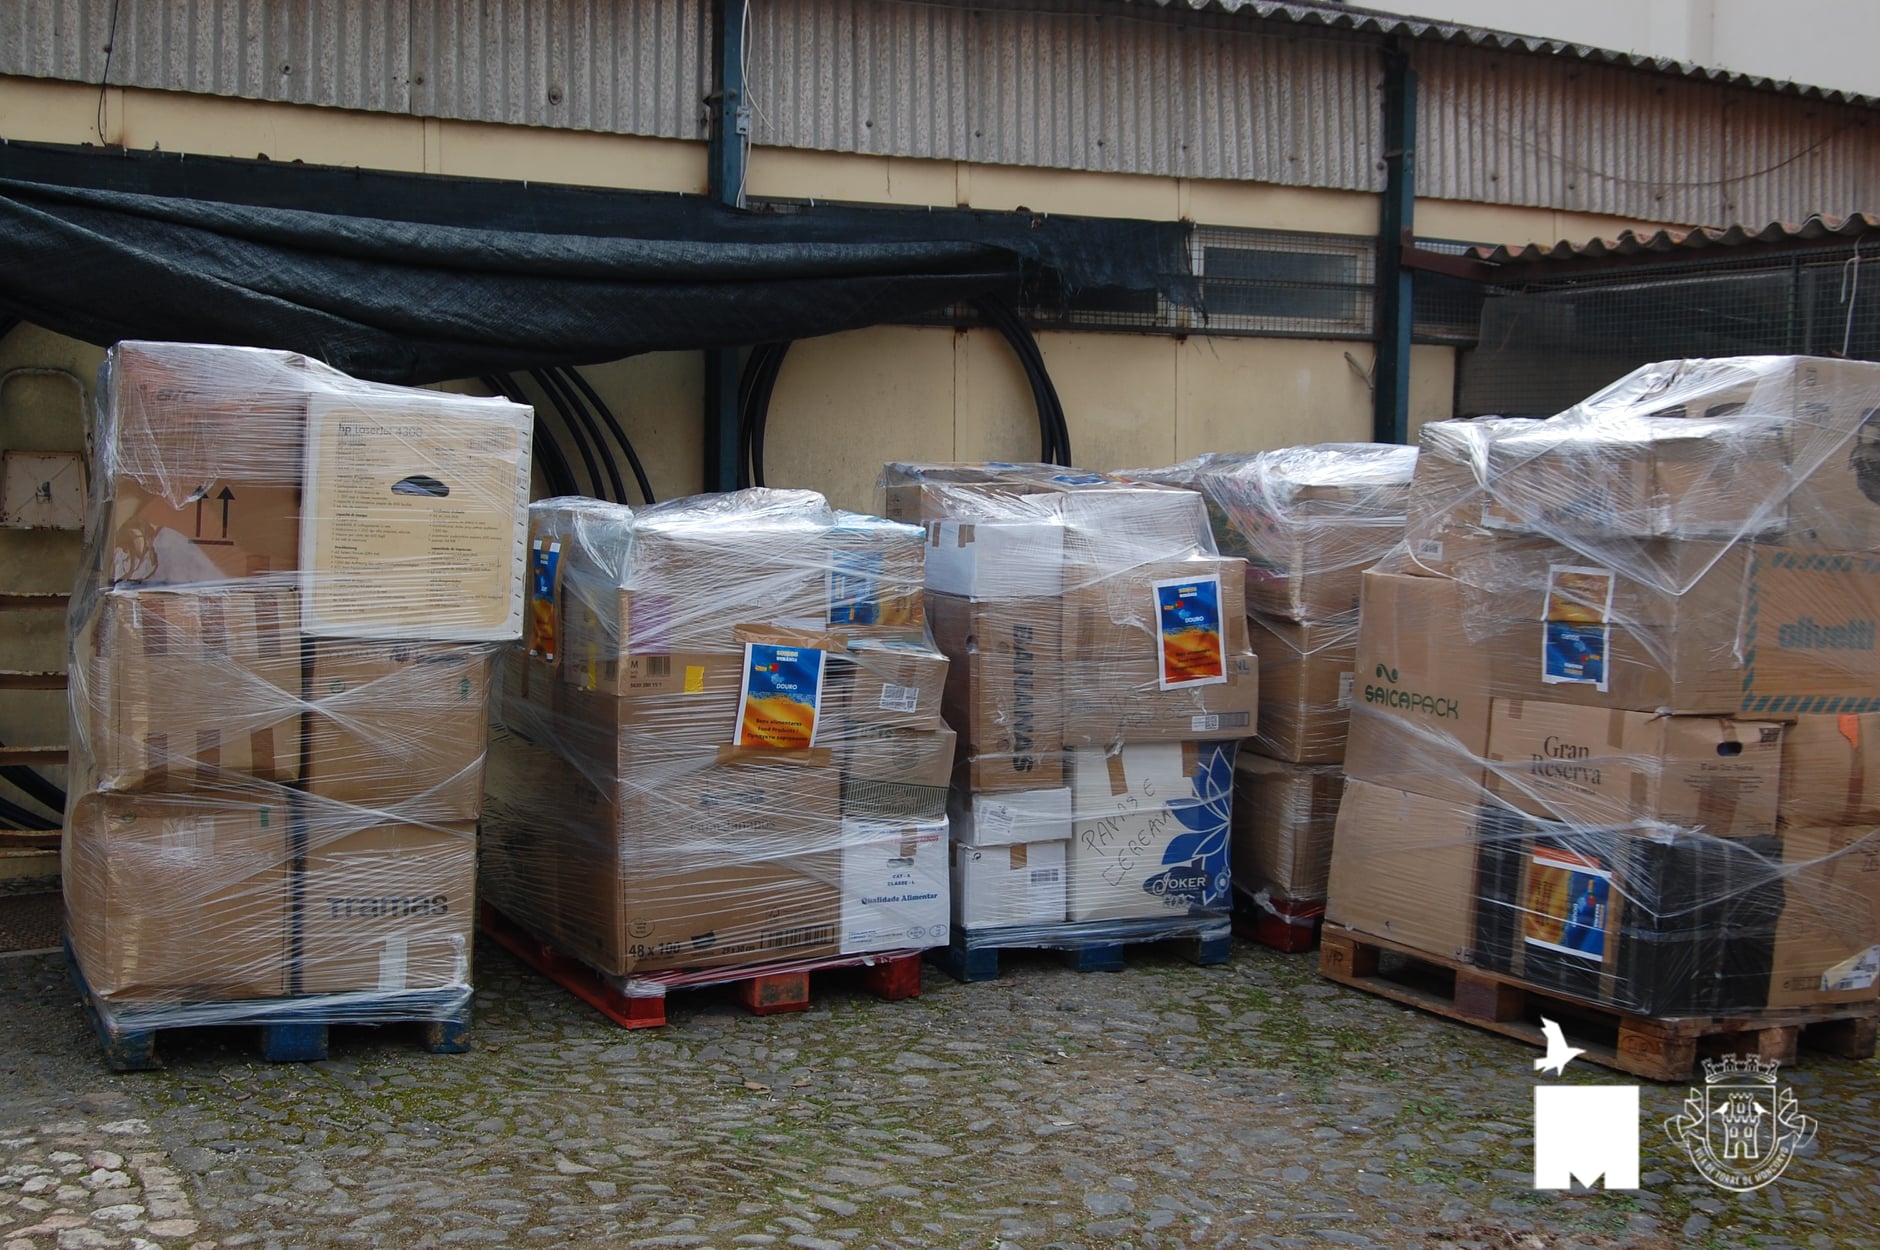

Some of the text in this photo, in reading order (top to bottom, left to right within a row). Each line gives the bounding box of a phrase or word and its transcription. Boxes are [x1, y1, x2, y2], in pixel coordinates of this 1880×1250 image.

[338, 423, 352, 436] hp
[1364, 684, 1459, 720] SAICAPACK
[1543, 735, 1590, 761] Gran
[1530, 753, 1602, 785] Reserva
[1152, 871, 1206, 895] JOKER
[861, 892, 938, 905] Qualidade Alimentar
[628, 944, 645, 958] 48
